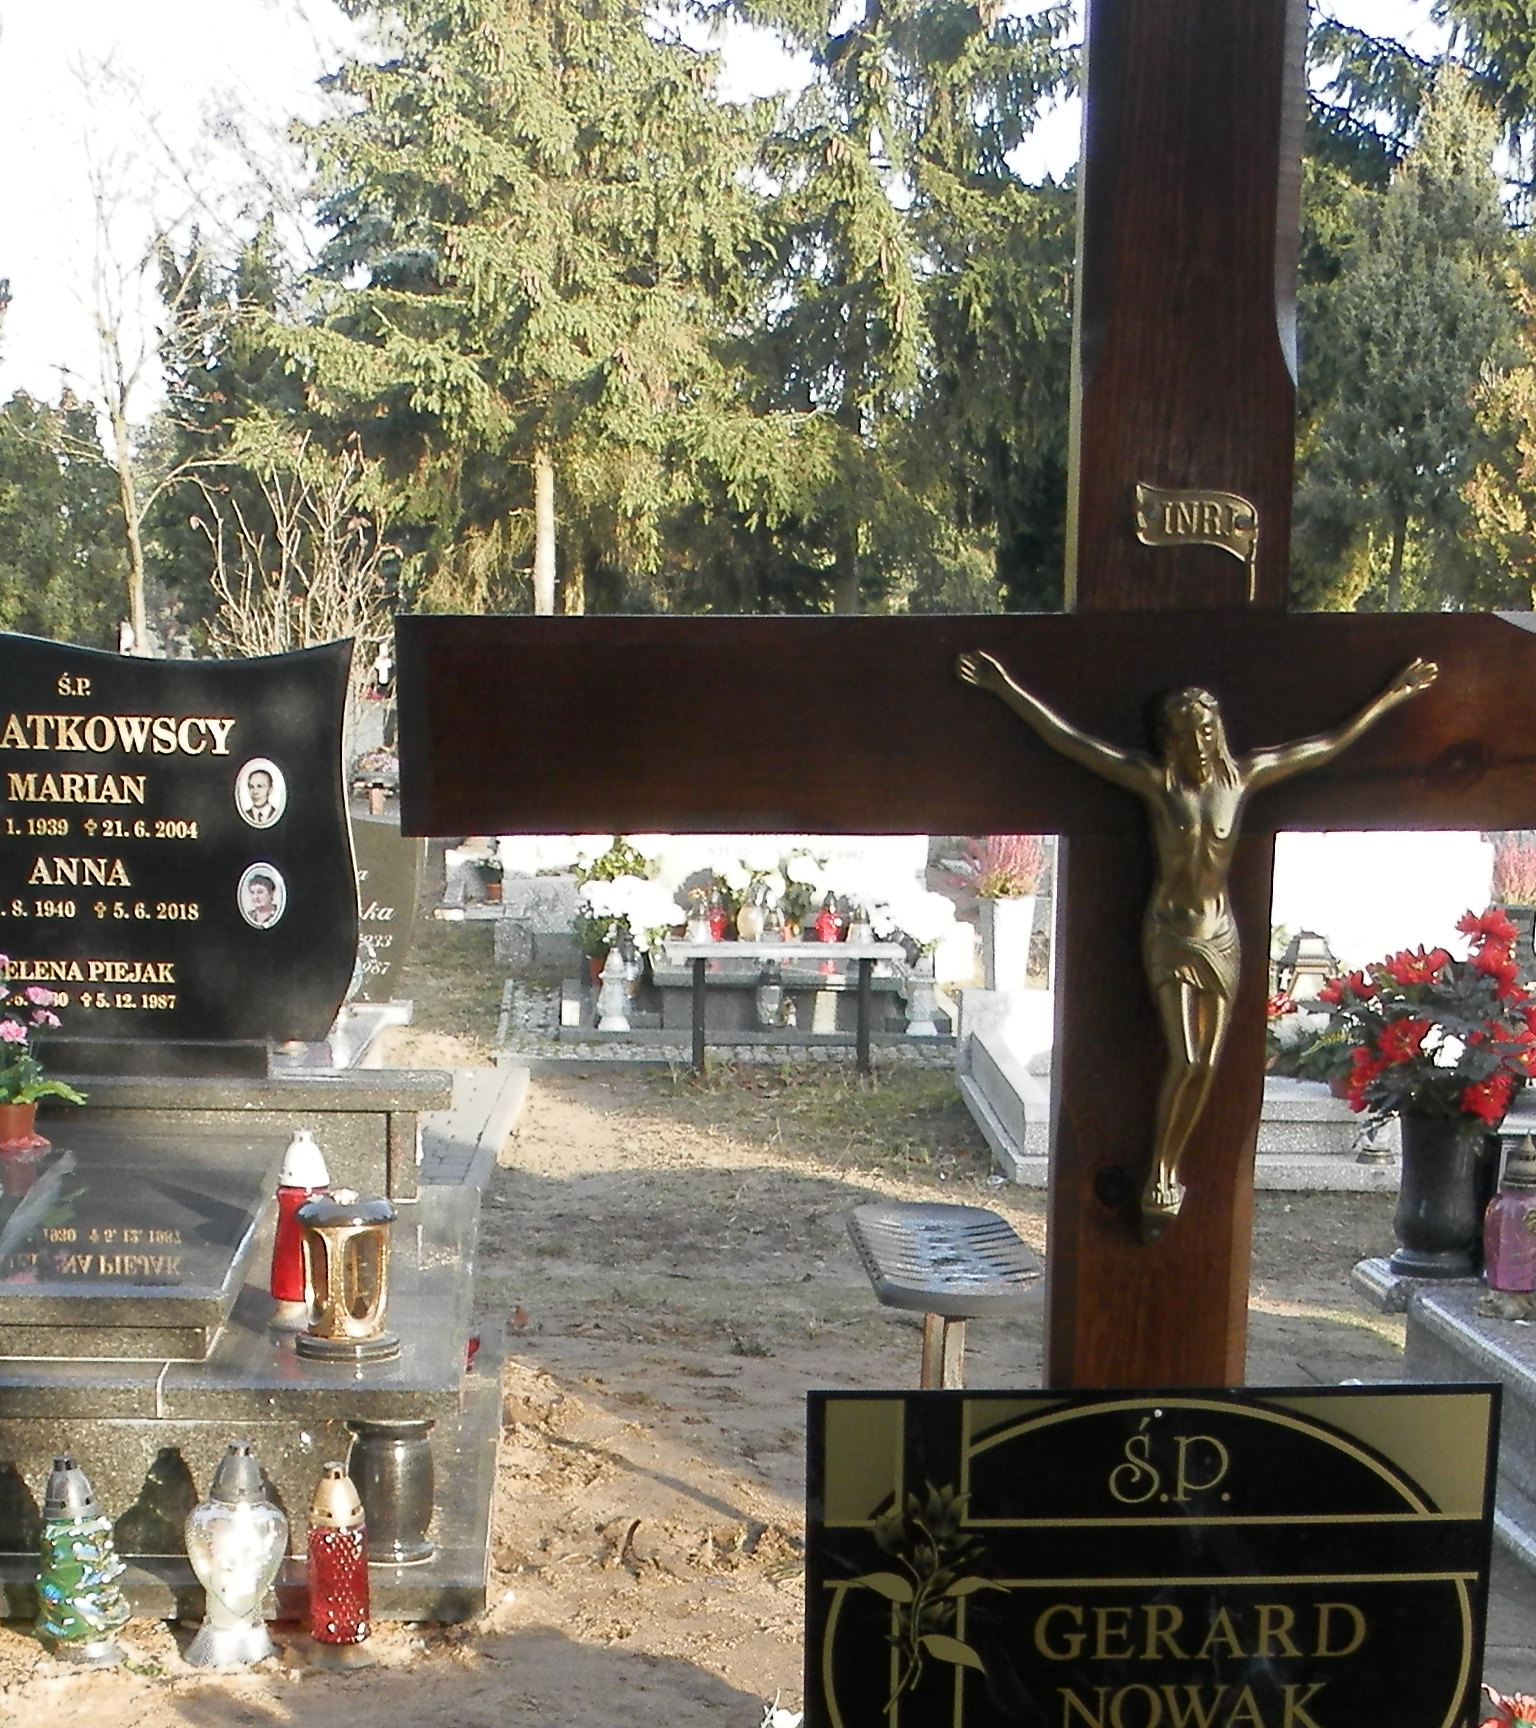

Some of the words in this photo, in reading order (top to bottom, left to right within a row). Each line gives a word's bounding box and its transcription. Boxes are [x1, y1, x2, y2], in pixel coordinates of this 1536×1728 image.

[1163, 500, 1235, 536] INRI
[57, 672, 92, 696] Ś.P.
[7, 772, 147, 805] MARIAN
[6, 818, 21, 836] 1.
[27, 818, 69, 837] 1939
[101, 820, 130, 838] 21.
[133, 820, 151, 838] 6.
[154, 820, 199, 839] 2004
[27, 856, 132, 887] ANNA
[11, 900, 28, 917] 8.
[34, 899, 76, 918] 1940
[112, 902, 130, 919] 5.
[134, 902, 152, 919] 6.
[156, 902, 200, 921] 2018
[2, 960, 85, 982] ELENA
[87, 960, 176, 983] PIEJAK
[95, 992, 112, 1008] 5.
[115, 993, 137, 1009] 12.
[141, 993, 176, 1010] 1987
[1033, 1600, 1366, 1662] GERARD
